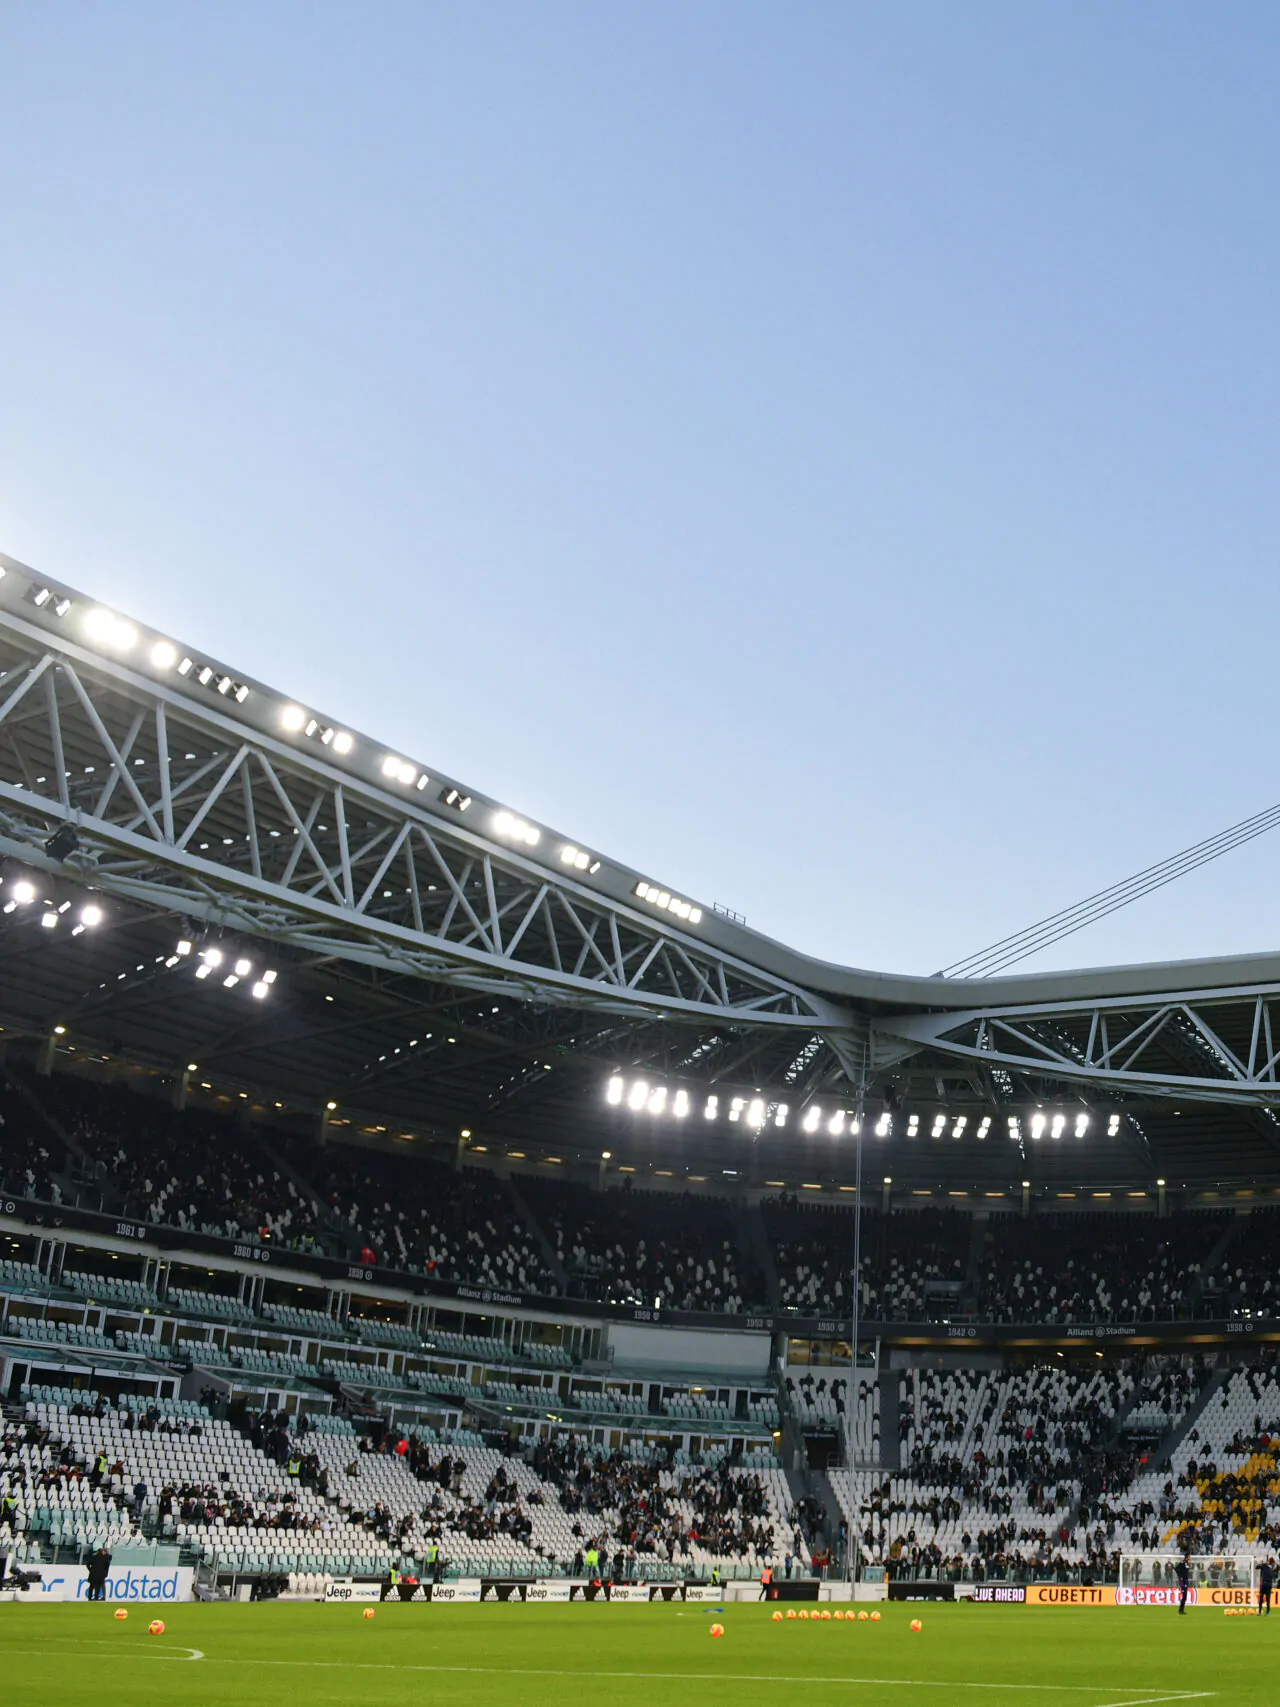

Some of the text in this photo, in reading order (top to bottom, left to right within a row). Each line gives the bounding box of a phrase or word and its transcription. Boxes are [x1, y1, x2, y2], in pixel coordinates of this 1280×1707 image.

[116, 1223, 135, 1237] 1961
[457, 1286, 522, 1304] Allianz Stadium
[948, 1328, 966, 1337] 1942
[1067, 1327, 1136, 1336] Allianz Stadium
[327, 1585, 352, 1599] Jeep
[433, 1585, 455, 1599] Jeep
[527, 1587, 547, 1599] Jeep
[611, 1588, 629, 1599] Jeep
[686, 1588, 703, 1599] Jeep
[975, 1587, 1025, 1602] LIVE AHEAD
[1038, 1588, 1102, 1602] CUBETTI
[1211, 1590, 1278, 1605] CUBEI
